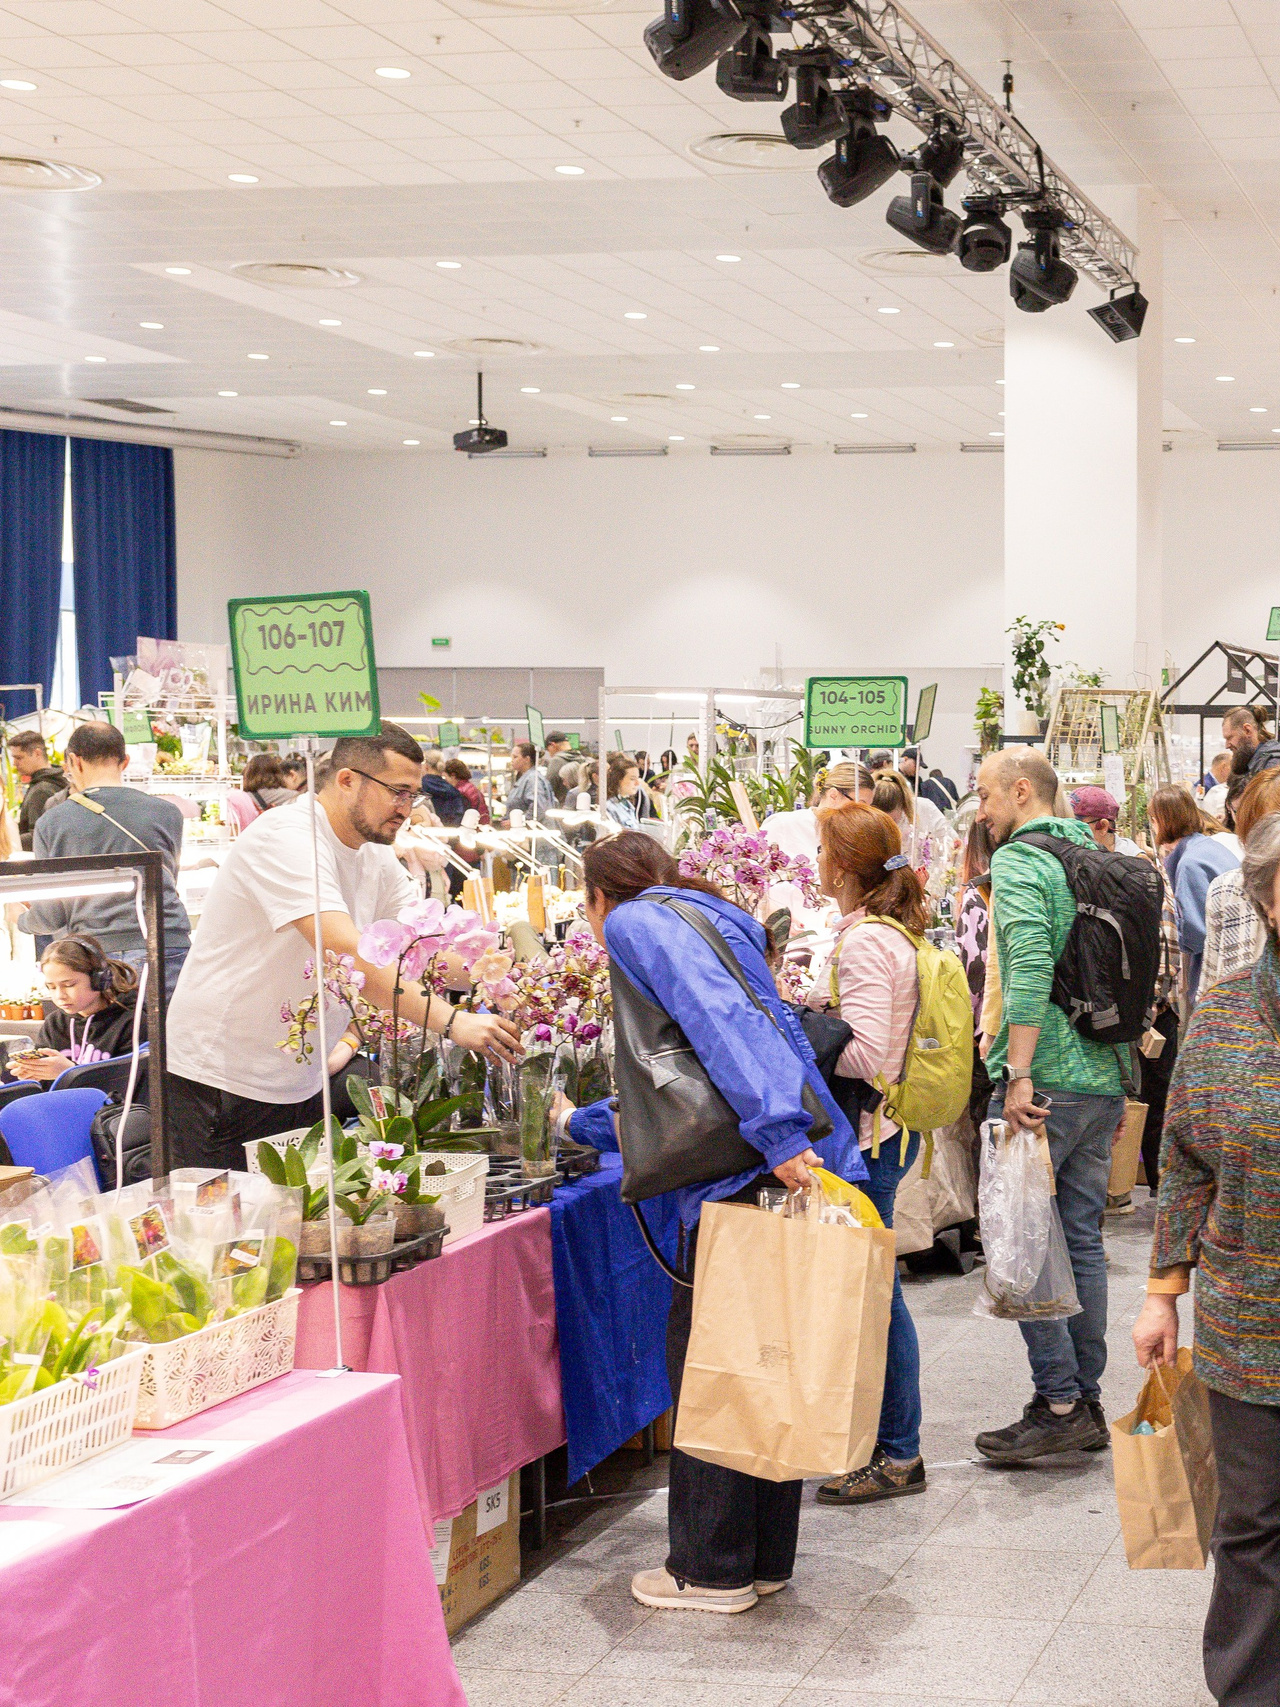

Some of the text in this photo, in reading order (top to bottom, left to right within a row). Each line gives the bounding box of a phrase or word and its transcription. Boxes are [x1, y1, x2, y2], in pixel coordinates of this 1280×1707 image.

[258, 620, 345, 650] 106-107
[247, 690, 373, 715] ИРИНА КИМ
[820, 690, 886, 705] 104-105
[851, 725, 897, 734] ORCHID
